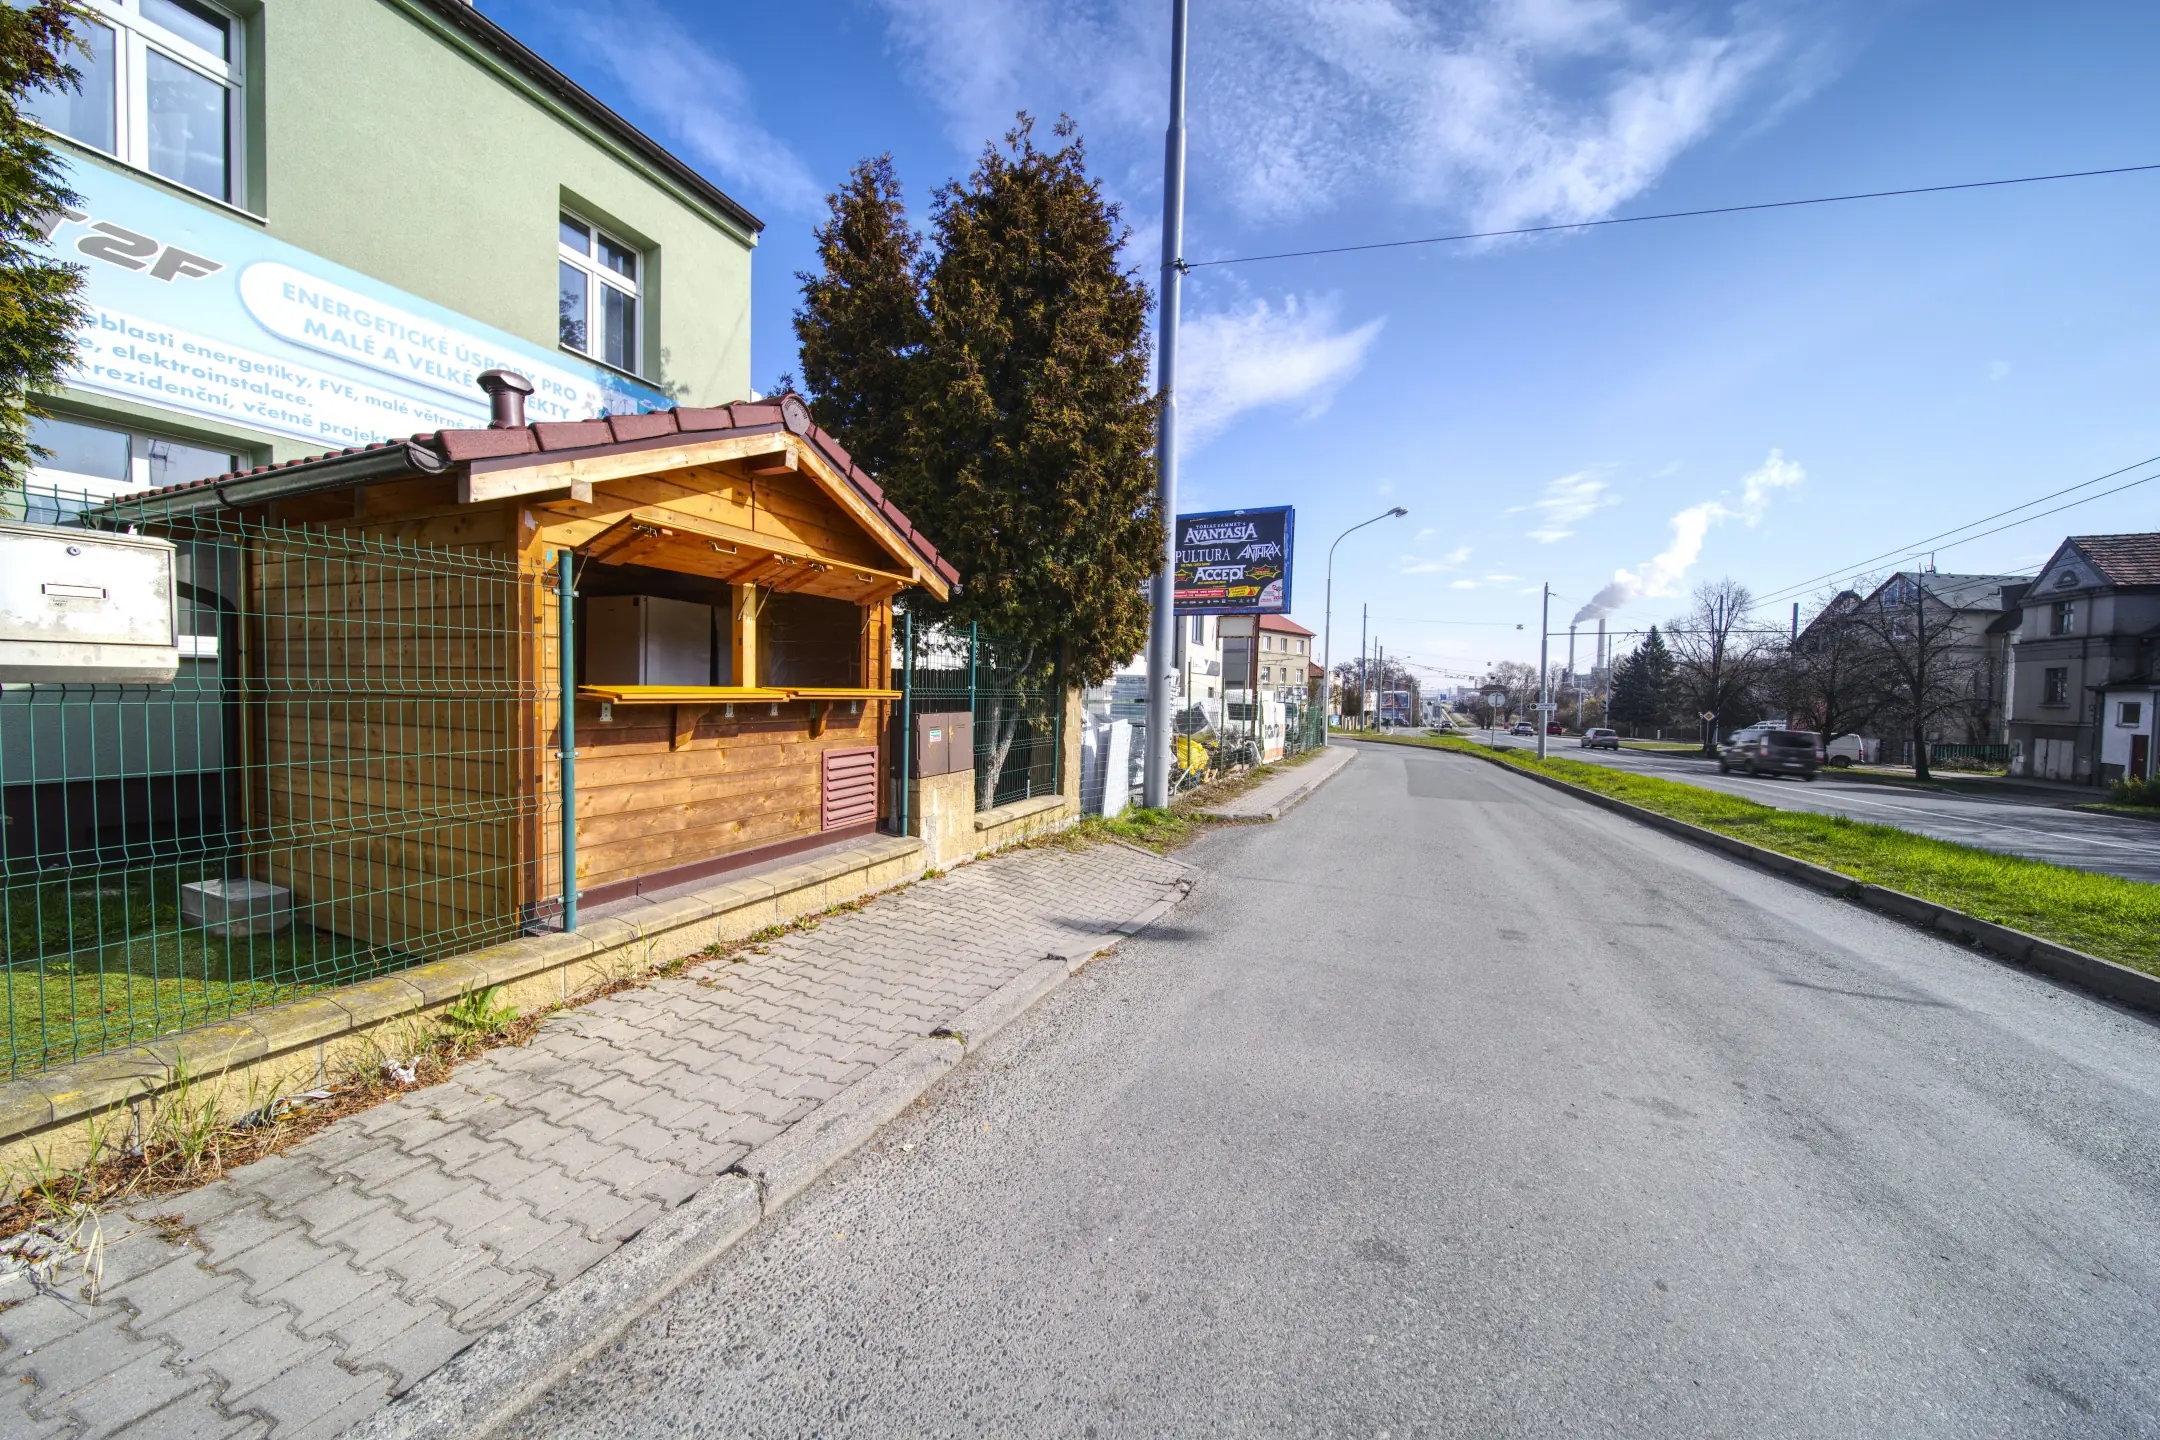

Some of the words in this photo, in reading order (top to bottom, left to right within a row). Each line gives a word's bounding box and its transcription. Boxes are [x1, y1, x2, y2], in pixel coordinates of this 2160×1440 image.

[283, 282, 448, 355] ENERGETICKÉ
[541, 378, 577, 401] PRO
[304, 318, 374, 355] MALÉ
[383, 347, 399, 364] A
[408, 353, 472, 387] VELKÉ
[94, 364, 235, 410] rezidenční,
[243, 402, 313, 427] včetně
[112, 345, 313, 408] elektroinstalace.
[182, 342, 311, 388] energetiky,
[320, 379, 358, 401] FVE,
[365, 395, 408, 414] malé
[414, 408, 465, 429] větrné
[1184, 523, 1258, 545] AVANTASIA
[1237, 541, 1282, 563] ANTHRAX
